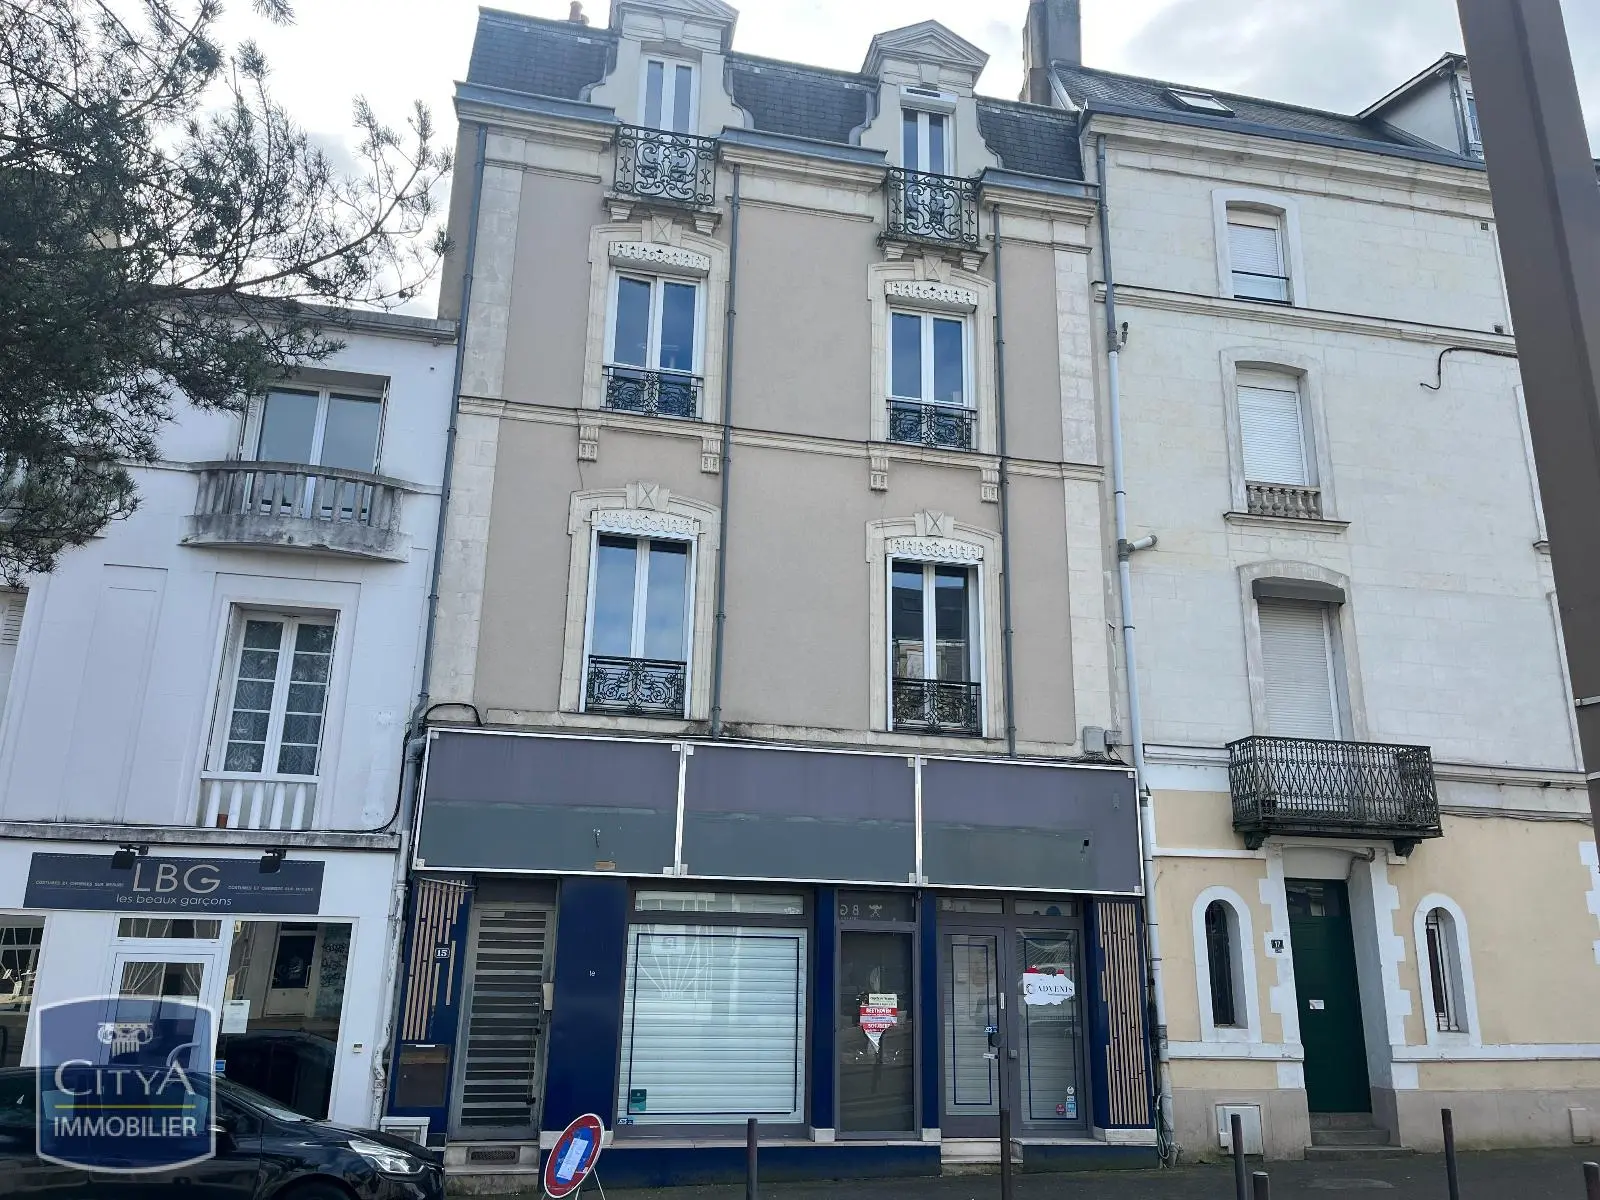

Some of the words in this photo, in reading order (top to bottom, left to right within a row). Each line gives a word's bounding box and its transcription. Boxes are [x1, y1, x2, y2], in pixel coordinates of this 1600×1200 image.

[133, 863, 220, 893] LBG
[116, 893, 133, 903] les
[136, 895, 177, 905] beaux
[180, 897, 232, 907] garçons
[1274, 940, 1281, 948] 17
[437, 949, 448, 957] 15
